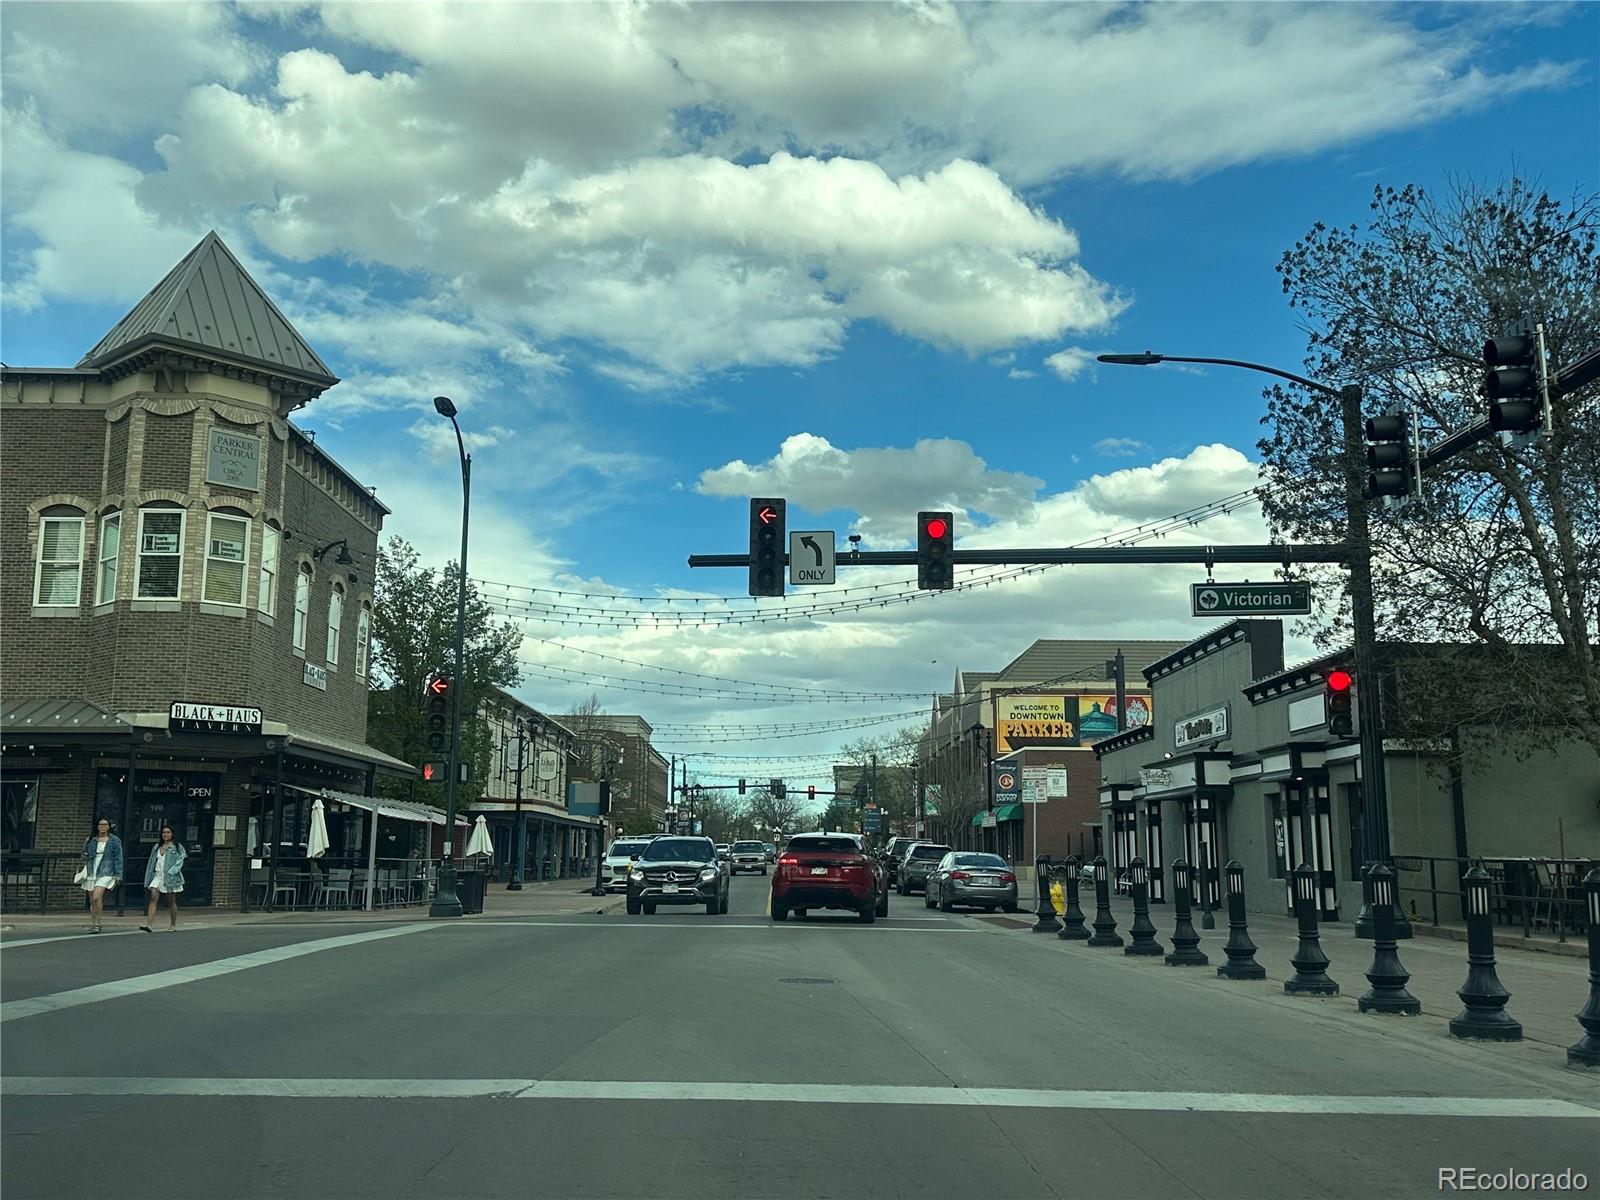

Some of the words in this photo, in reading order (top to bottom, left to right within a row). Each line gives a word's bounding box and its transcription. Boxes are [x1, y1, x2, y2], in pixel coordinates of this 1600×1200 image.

[217, 436, 253, 450] PARKER
[213, 444, 256, 460] CENTRAL
[798, 569, 826, 580] ONLY
[1223, 591, 1292, 606] Victorian
[1010, 712, 1064, 720] DOWNTOWN
[1003, 720, 1074, 738] PARKER
[187, 787, 212, 797] OPEN
